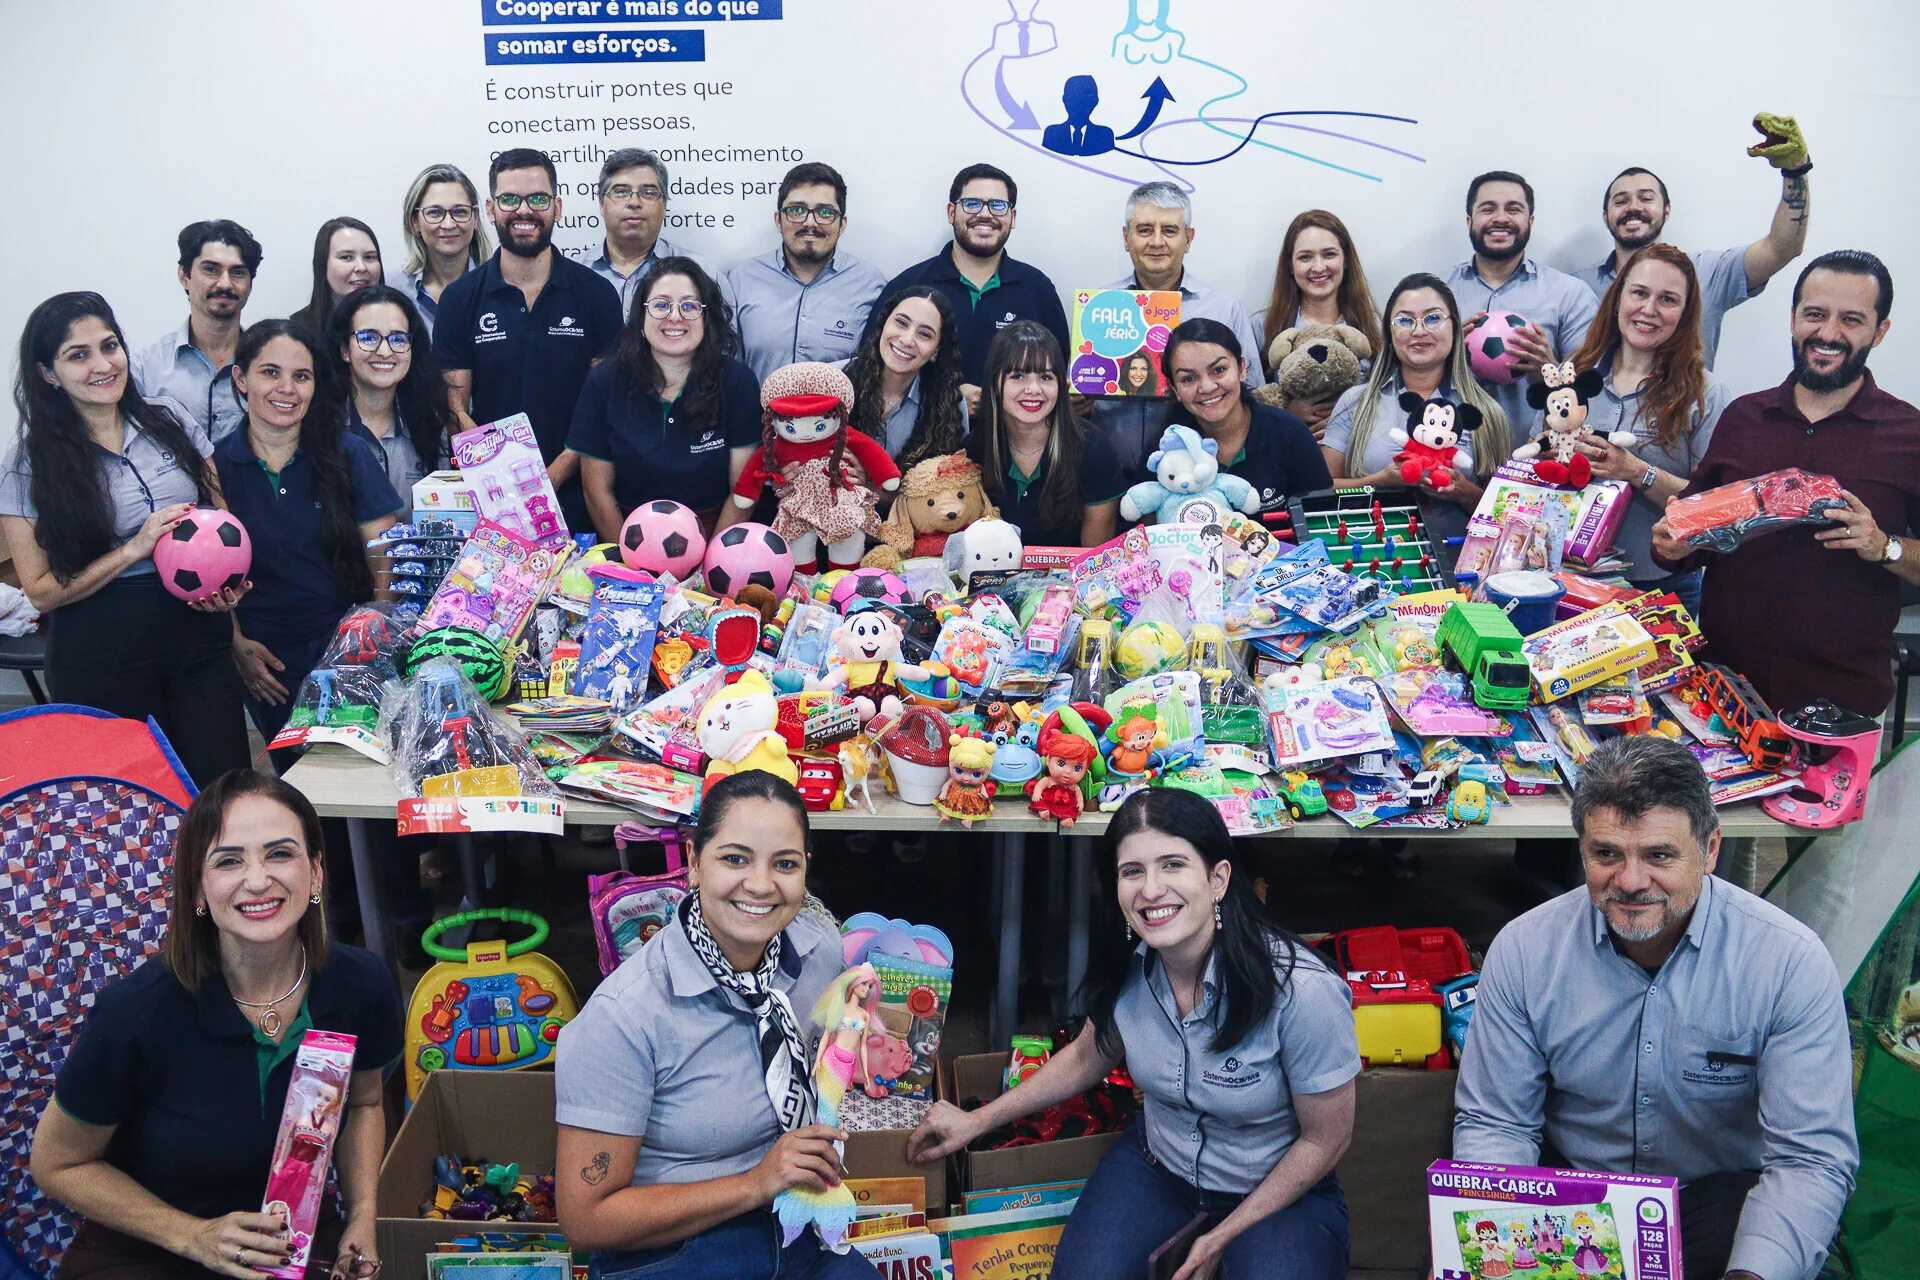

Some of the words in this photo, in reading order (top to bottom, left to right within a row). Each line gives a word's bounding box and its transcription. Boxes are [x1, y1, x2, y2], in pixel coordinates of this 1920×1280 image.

[496, 0, 602, 21] Cooperar
[625, 0, 679, 16] mais
[684, 0, 713, 16] do
[717, 0, 759, 21] que
[497, 39, 568, 55] somar
[572, 33, 678, 58] esforços.
[486, 78, 497, 101] É
[504, 80, 604, 100] construir
[611, 80, 686, 103] pontes
[693, 81, 733, 101] que
[488, 116, 595, 134] conectam
[602, 115, 696, 136] pessoas,
[741, 181, 784, 200] par
[663, 209, 716, 228] forte
[723, 215, 734, 228] e
[1091, 308, 1134, 329] FALA
[1104, 325, 1140, 339] SÉRIO
[1147, 532, 1197, 545] Doctor
[1090, 561, 1112, 575] HOME
[1397, 602, 1447, 616] MEMÓRIA
[1570, 666, 1606, 684] FAZENDINHA
[1554, 680, 1565, 689] 20
[412, 804, 452, 814] PRETA
[882, 982, 907, 993] migos
[1431, 1173, 1557, 1198] QUEBRA-CABEÇA
[1458, 1188, 1516, 1200] PRINCESINHAS
[1641, 1230, 1664, 1243] 128
[972, 1248, 1015, 1275] Tenha
[1017, 1242, 1058, 1257] Corag
[1647, 1254, 1661, 1264] +3
[1009, 1260, 1051, 1273] Pequeno
